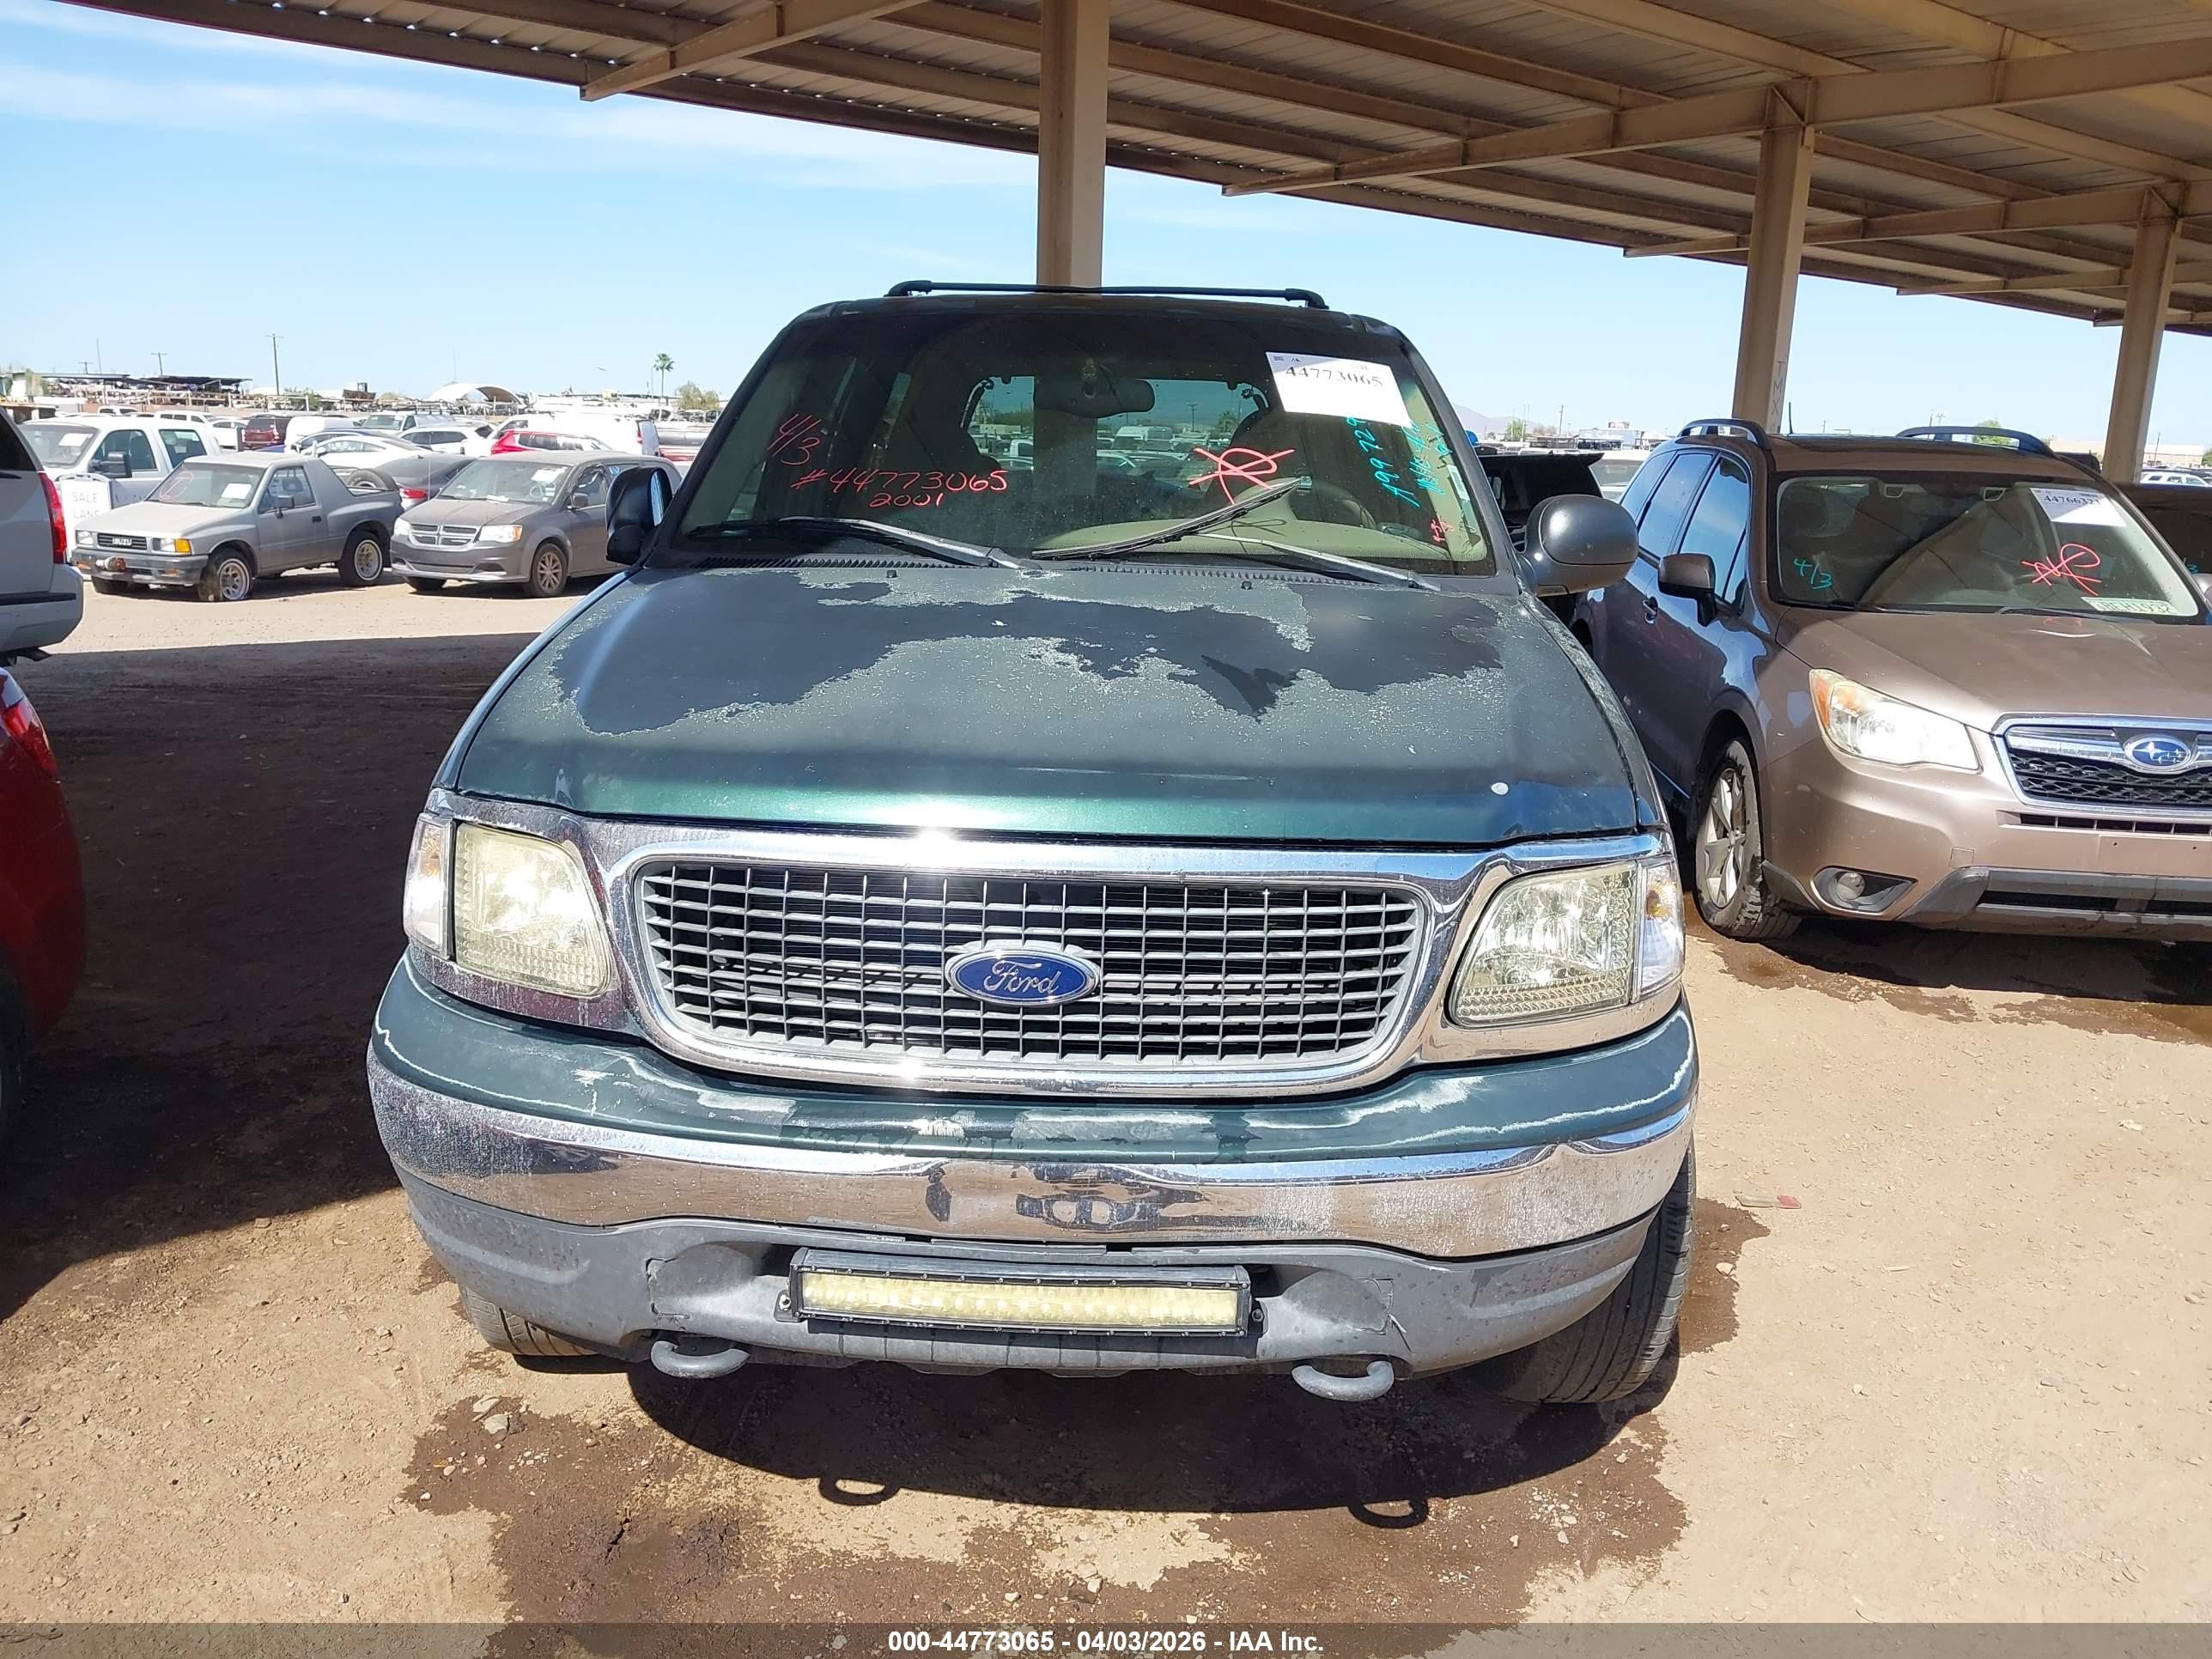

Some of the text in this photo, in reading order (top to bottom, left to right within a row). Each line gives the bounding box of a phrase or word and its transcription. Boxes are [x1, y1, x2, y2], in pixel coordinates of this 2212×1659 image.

[1285, 366, 1383, 387] 44773065
[767, 413, 822, 465] 4/3
[790, 467, 1009, 493] #44773065
[71, 491, 97, 503] SALE
[869, 492, 944, 507] 2001
[112, 537, 133, 546] ISUZU
[1793, 558, 1832, 589] 4/3
[983, 960, 1060, 994] Ford
